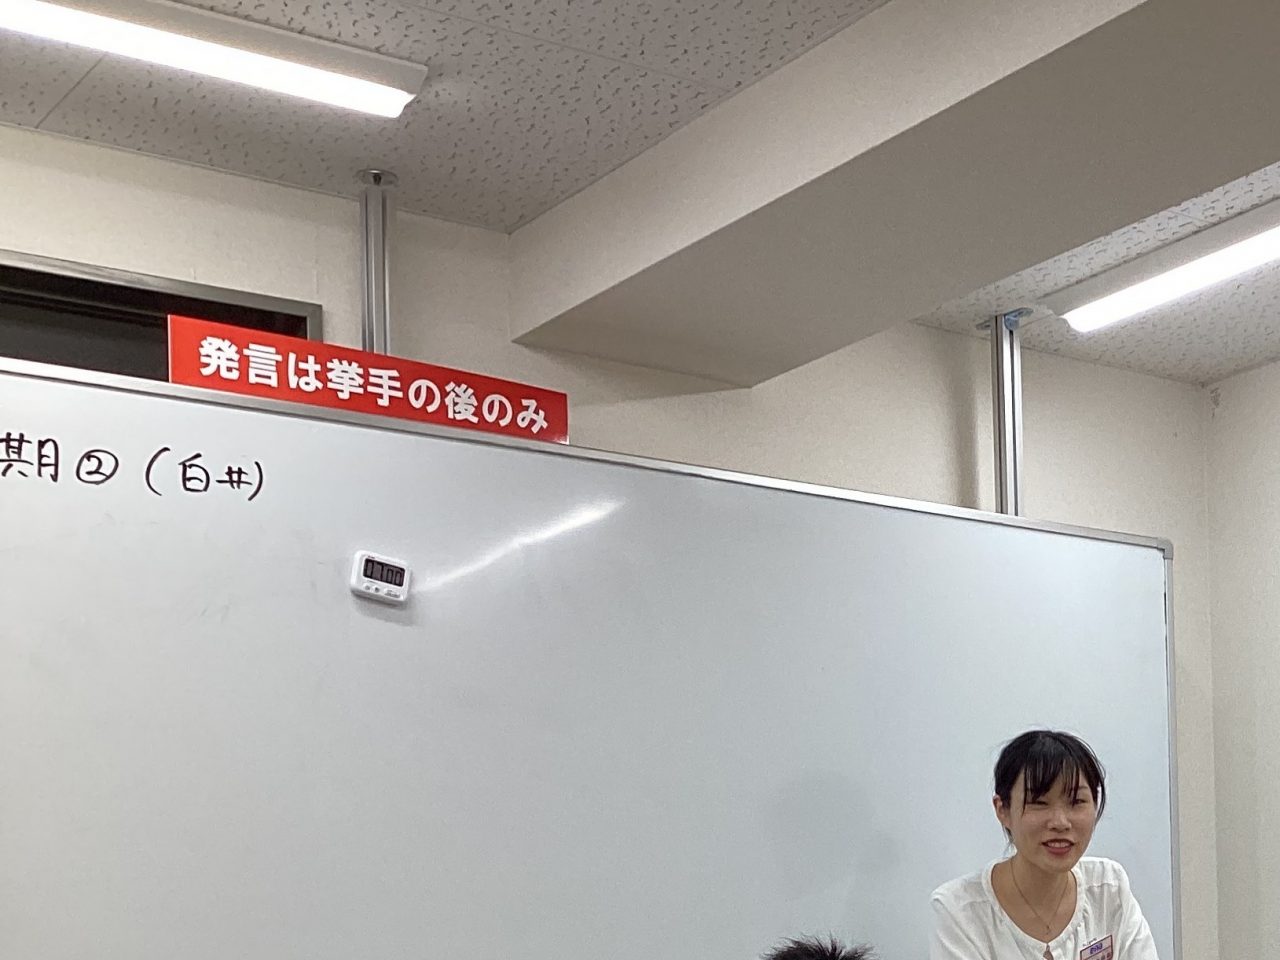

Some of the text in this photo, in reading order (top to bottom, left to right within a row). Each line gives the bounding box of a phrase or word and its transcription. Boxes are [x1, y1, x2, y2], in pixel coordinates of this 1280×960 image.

[199, 336, 548, 433] 発言は挙手の後のみ
